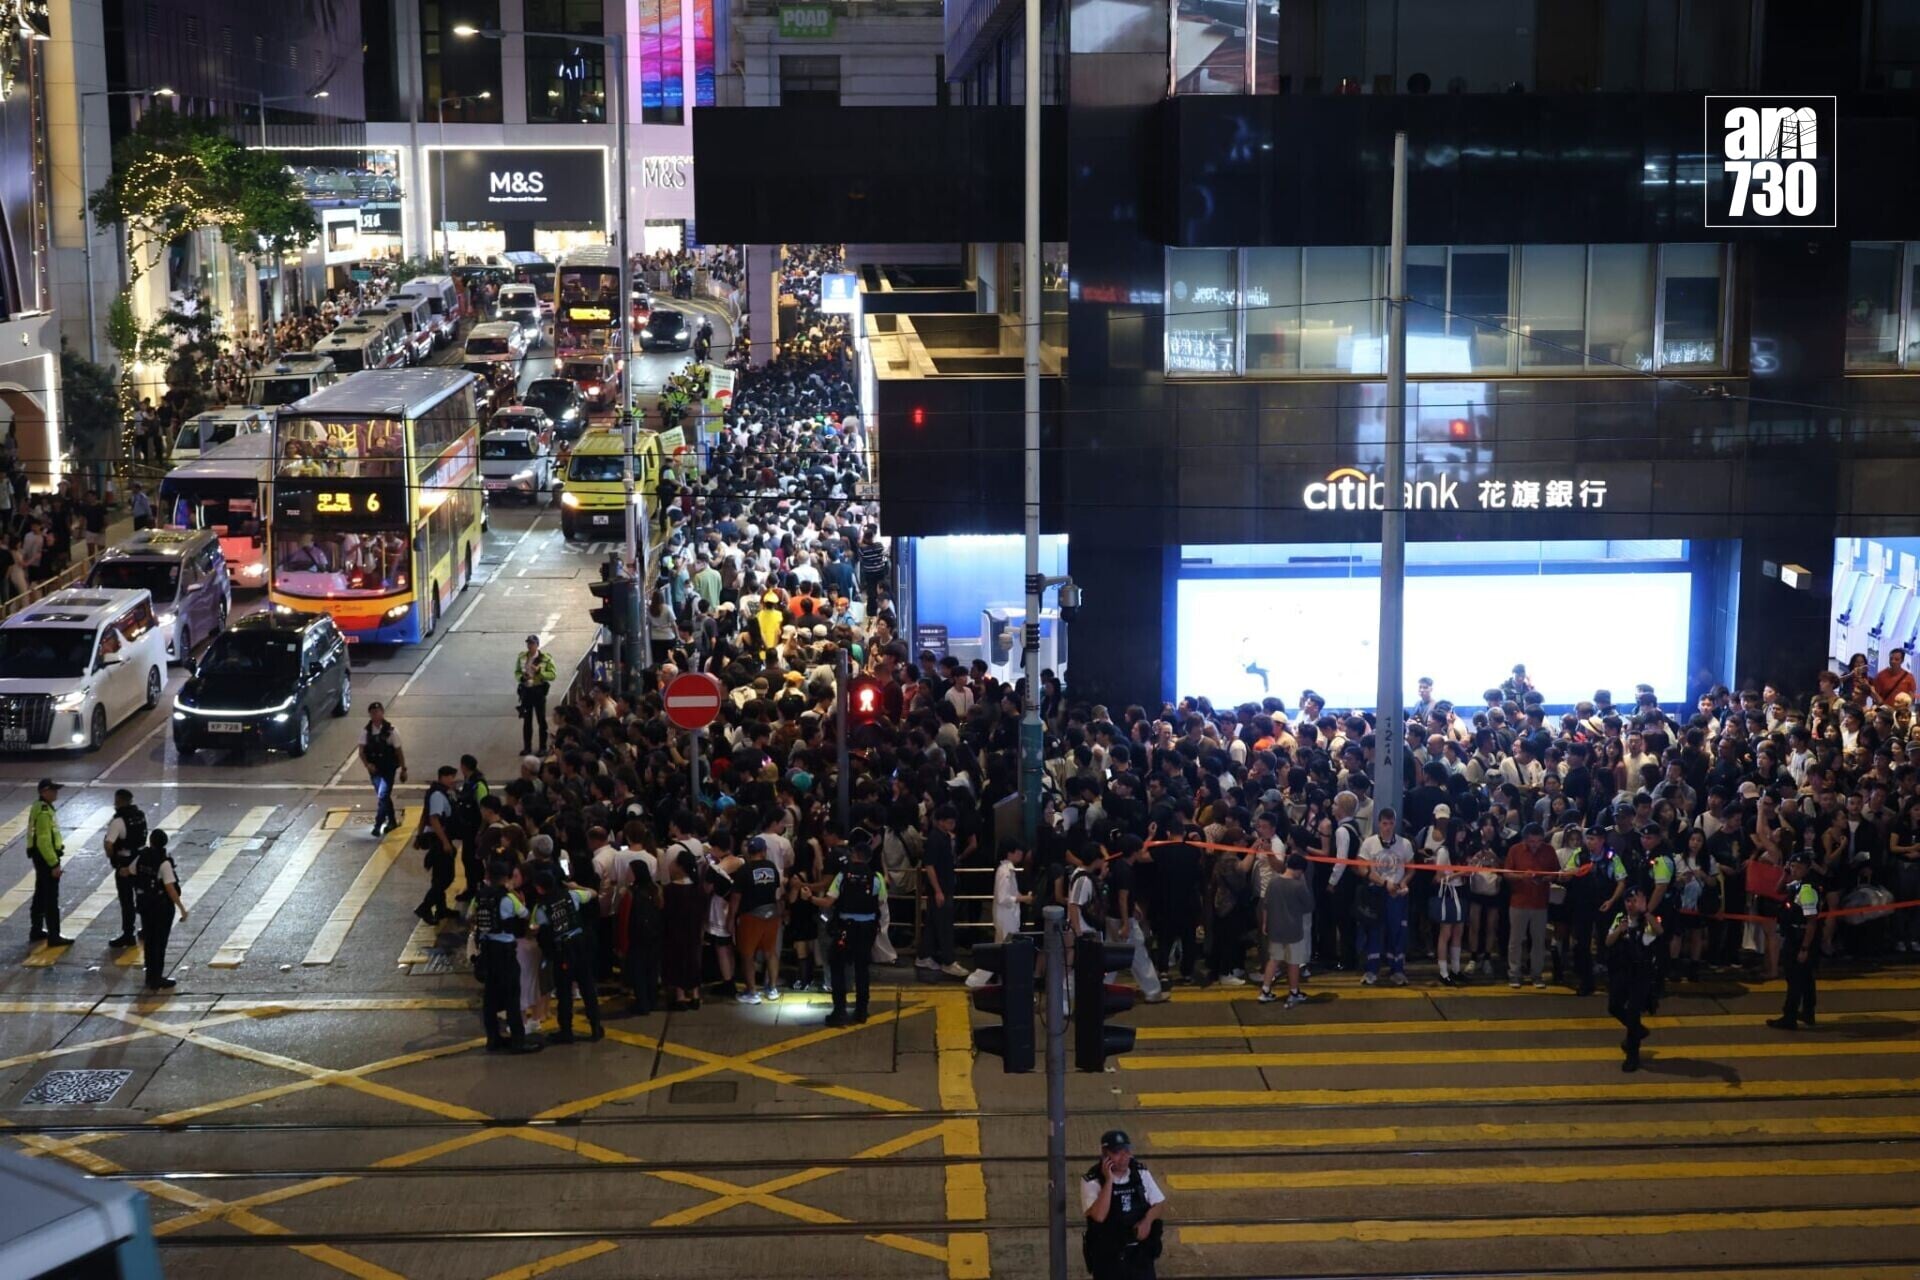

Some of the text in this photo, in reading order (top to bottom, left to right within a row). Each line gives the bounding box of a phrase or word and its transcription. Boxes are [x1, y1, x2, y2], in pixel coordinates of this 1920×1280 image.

[783, 9, 828, 27] POAD
[490, 172, 544, 193] M&S
[642, 157, 687, 190] M&S
[1303, 468, 1608, 511] citibank 花旗銀行
[367, 493, 380, 512] 6
